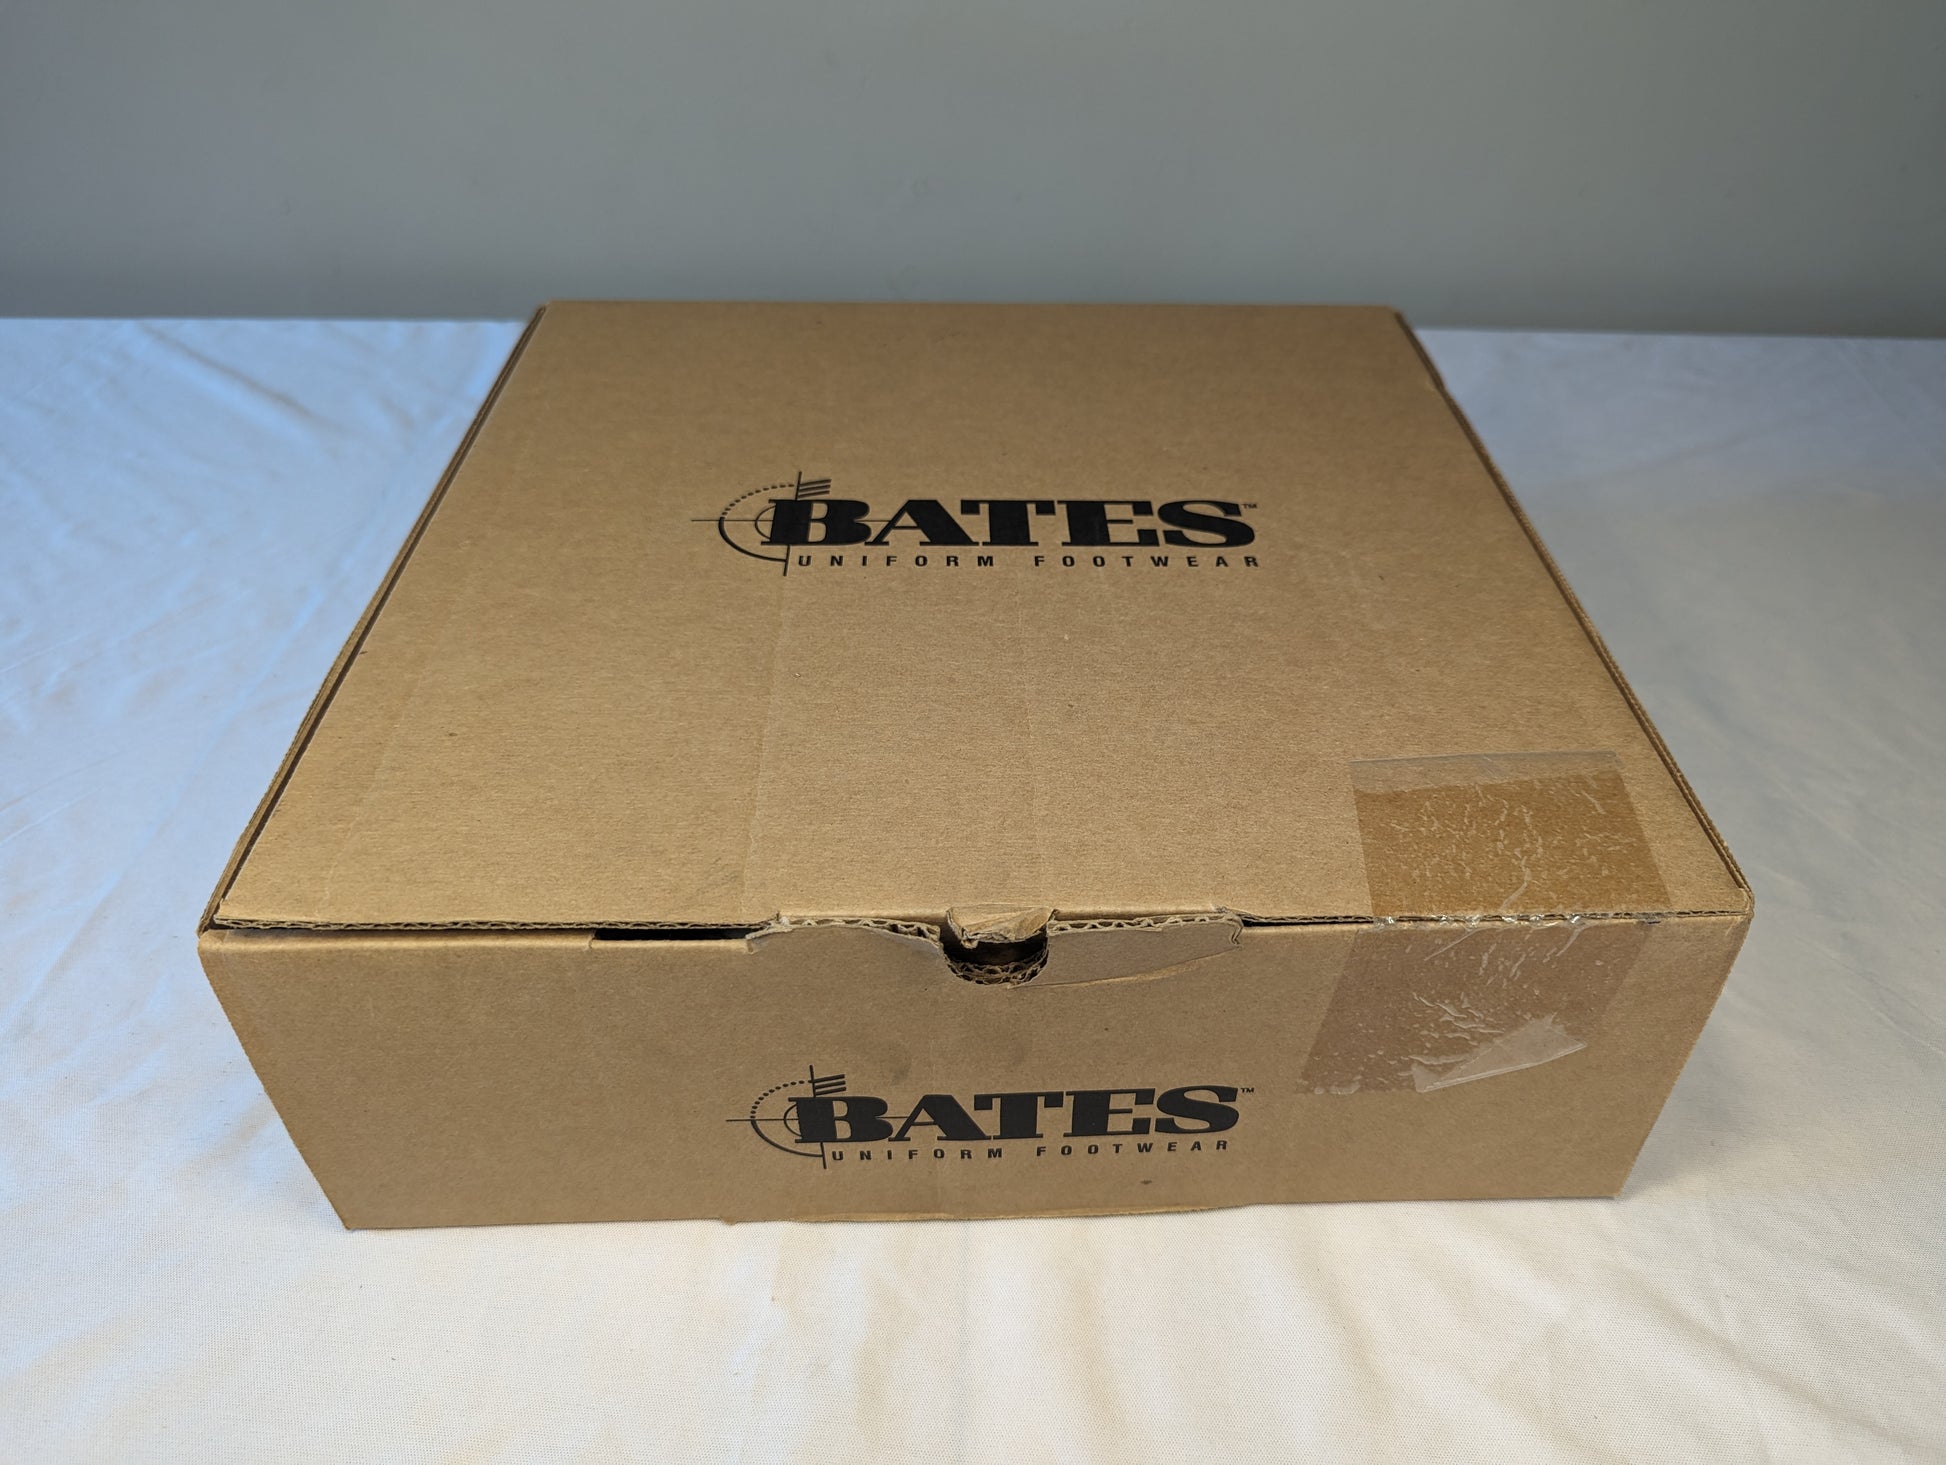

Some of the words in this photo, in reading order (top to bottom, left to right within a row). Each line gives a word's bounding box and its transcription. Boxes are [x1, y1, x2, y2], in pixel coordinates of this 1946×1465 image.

[759, 499, 1256, 549] BATES
[798, 555, 995, 568] UNIFORM
[1033, 555, 1260, 568] FOOTWEAR
[788, 1085, 1240, 1143] BATES
[832, 1147, 1003, 1162] UNIFORM
[1036, 1139, 1229, 1157] FOOTWEAR
